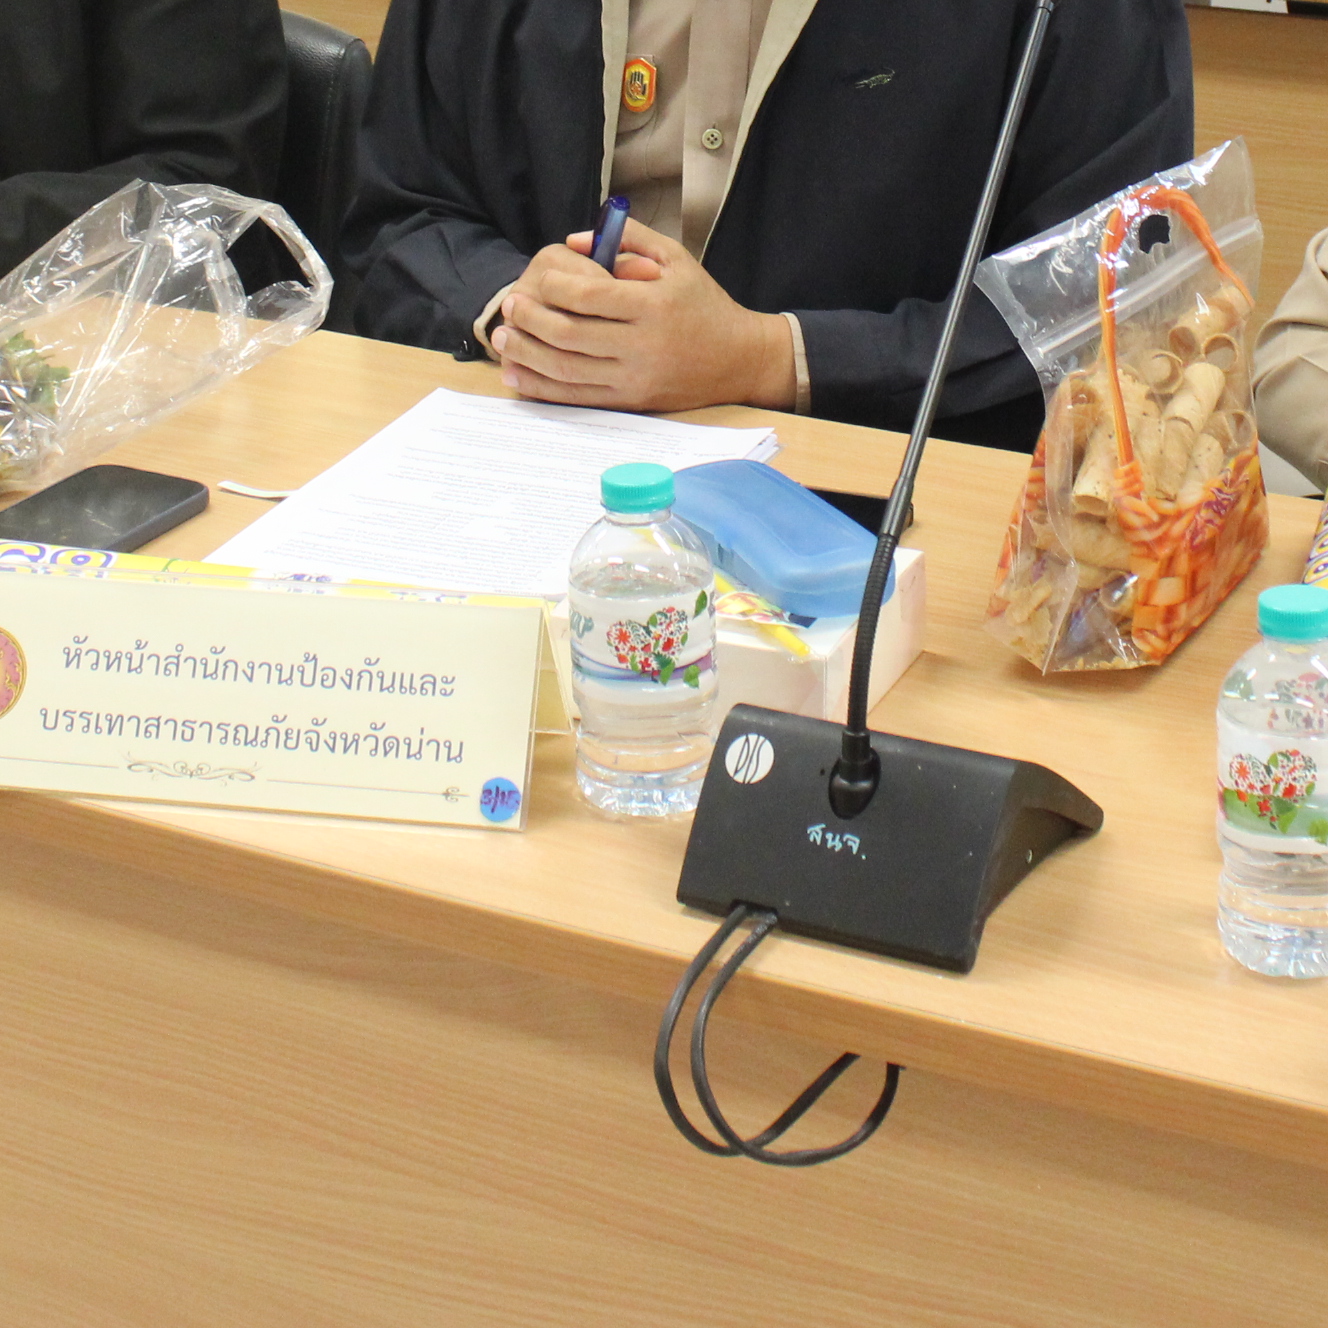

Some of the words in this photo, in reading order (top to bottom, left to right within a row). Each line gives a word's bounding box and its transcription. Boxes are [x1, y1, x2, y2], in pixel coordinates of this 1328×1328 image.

[62, 635, 456, 697] หัวหน้าสำนักงานป้องกันและ
[39, 707, 465, 764] บรรเทาสาธารณภัยจังหวัดน่าน
[807, 823, 867, 860] สนจ.
